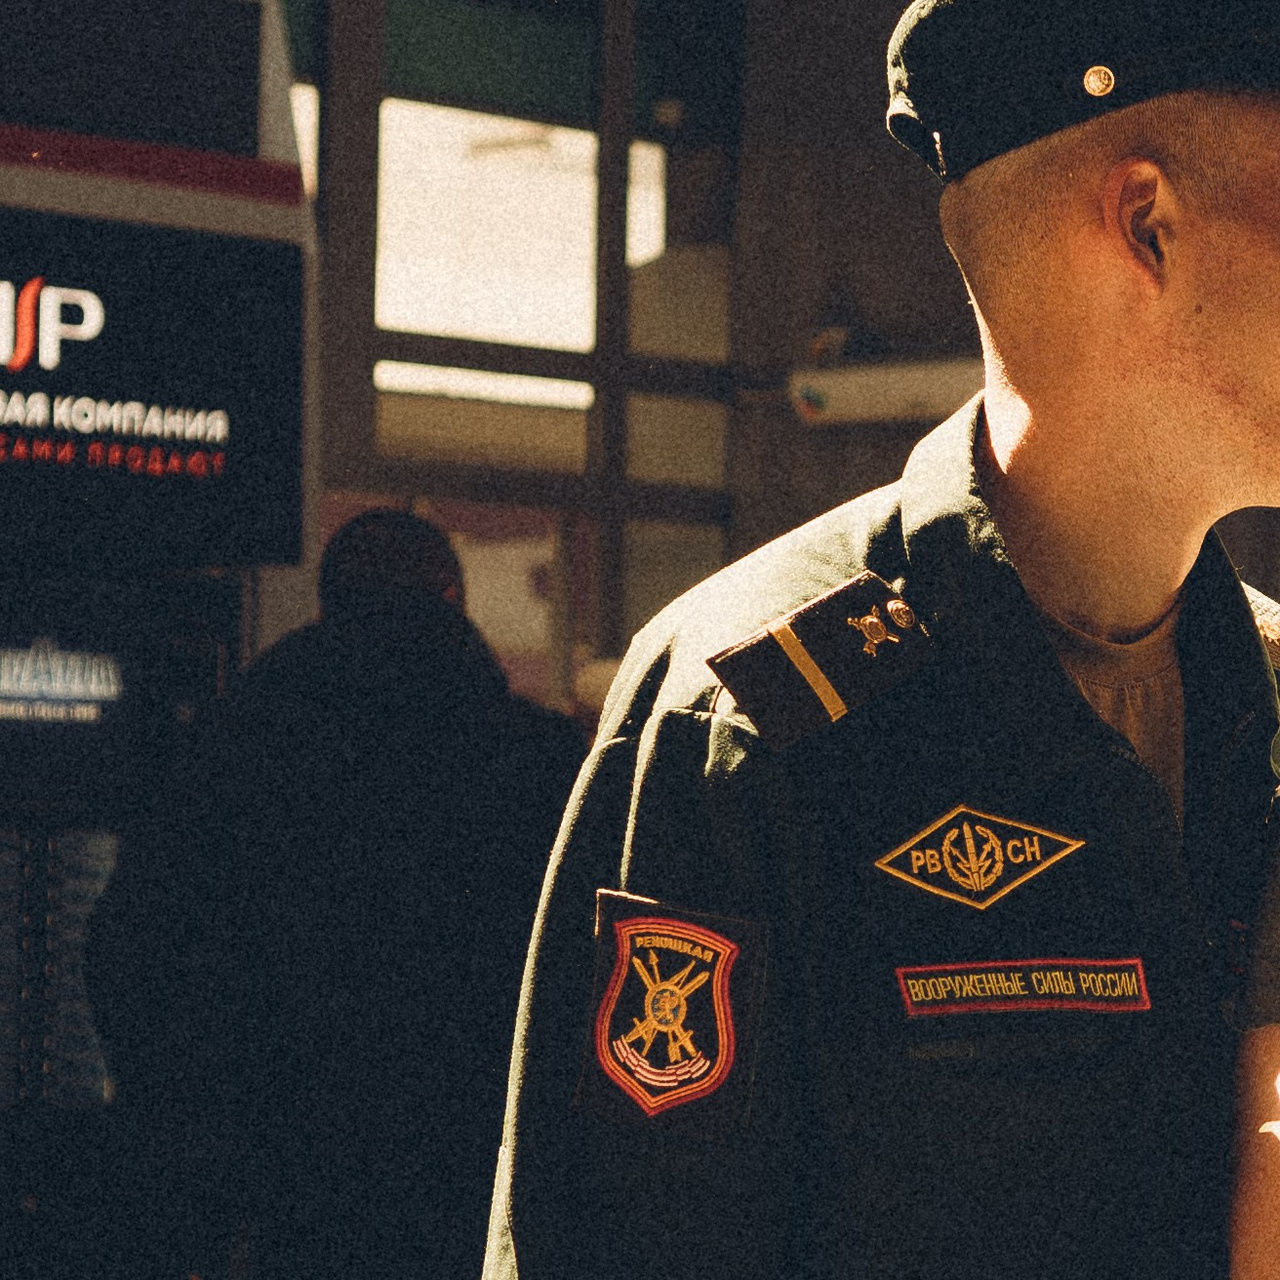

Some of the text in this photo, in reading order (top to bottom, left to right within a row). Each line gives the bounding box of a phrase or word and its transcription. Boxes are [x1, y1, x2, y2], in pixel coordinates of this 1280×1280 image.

[53, 395, 230, 444] КОМПАНИЯ
[87, 439, 227, 478] ПРОДАЮТ
[911, 836, 1042, 875] РВ СН
[907, 970, 1139, 1002] ВООРУЖЕННЫЕ СИЛЫ РОССИИ
